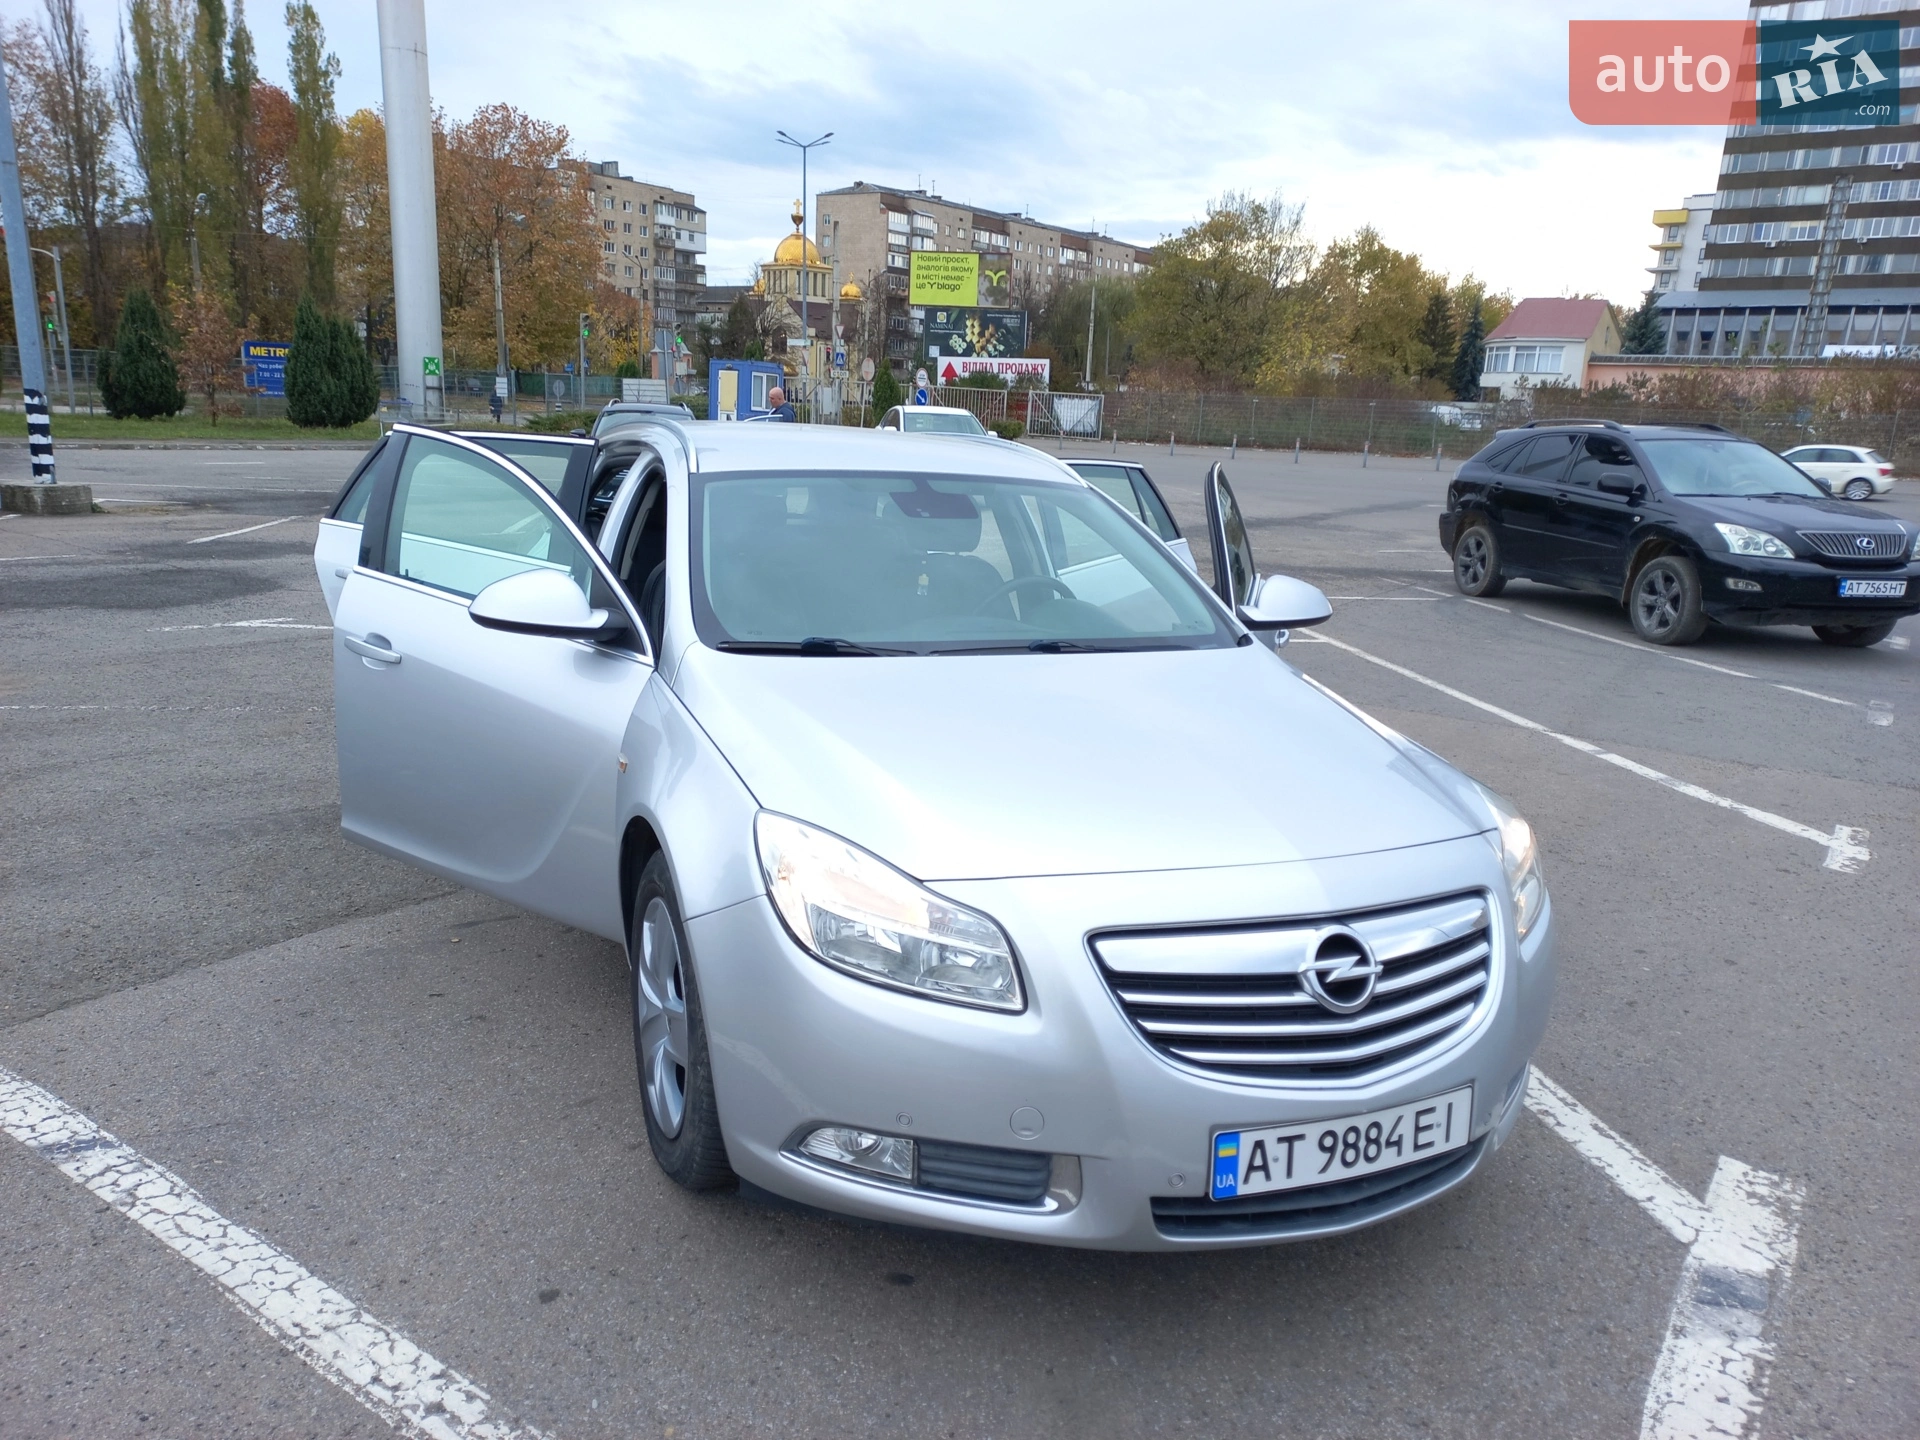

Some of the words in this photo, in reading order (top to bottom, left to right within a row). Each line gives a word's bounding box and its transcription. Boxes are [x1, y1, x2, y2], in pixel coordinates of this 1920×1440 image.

[917, 253, 941, 262] Новий
[941, 255, 970, 265] проєкт,
[916, 263, 950, 272] аналогів
[950, 266, 974, 275] якому
[921, 273, 940, 281] місті
[940, 274, 965, 282] немає
[915, 282, 927, 290] це
[962, 361, 994, 374] ВІДДІЛ
[997, 362, 1047, 376] ПРОДАЖУ
[1846, 582, 1863, 593] AT
[1863, 582, 1888, 594] 7565
[1888, 583, 1905, 594] HT
[1243, 1133, 1306, 1185] AT
[1317, 1115, 1404, 1175] 9884
[1413, 1102, 1453, 1153] EI
[1216, 1173, 1235, 1188] UA
